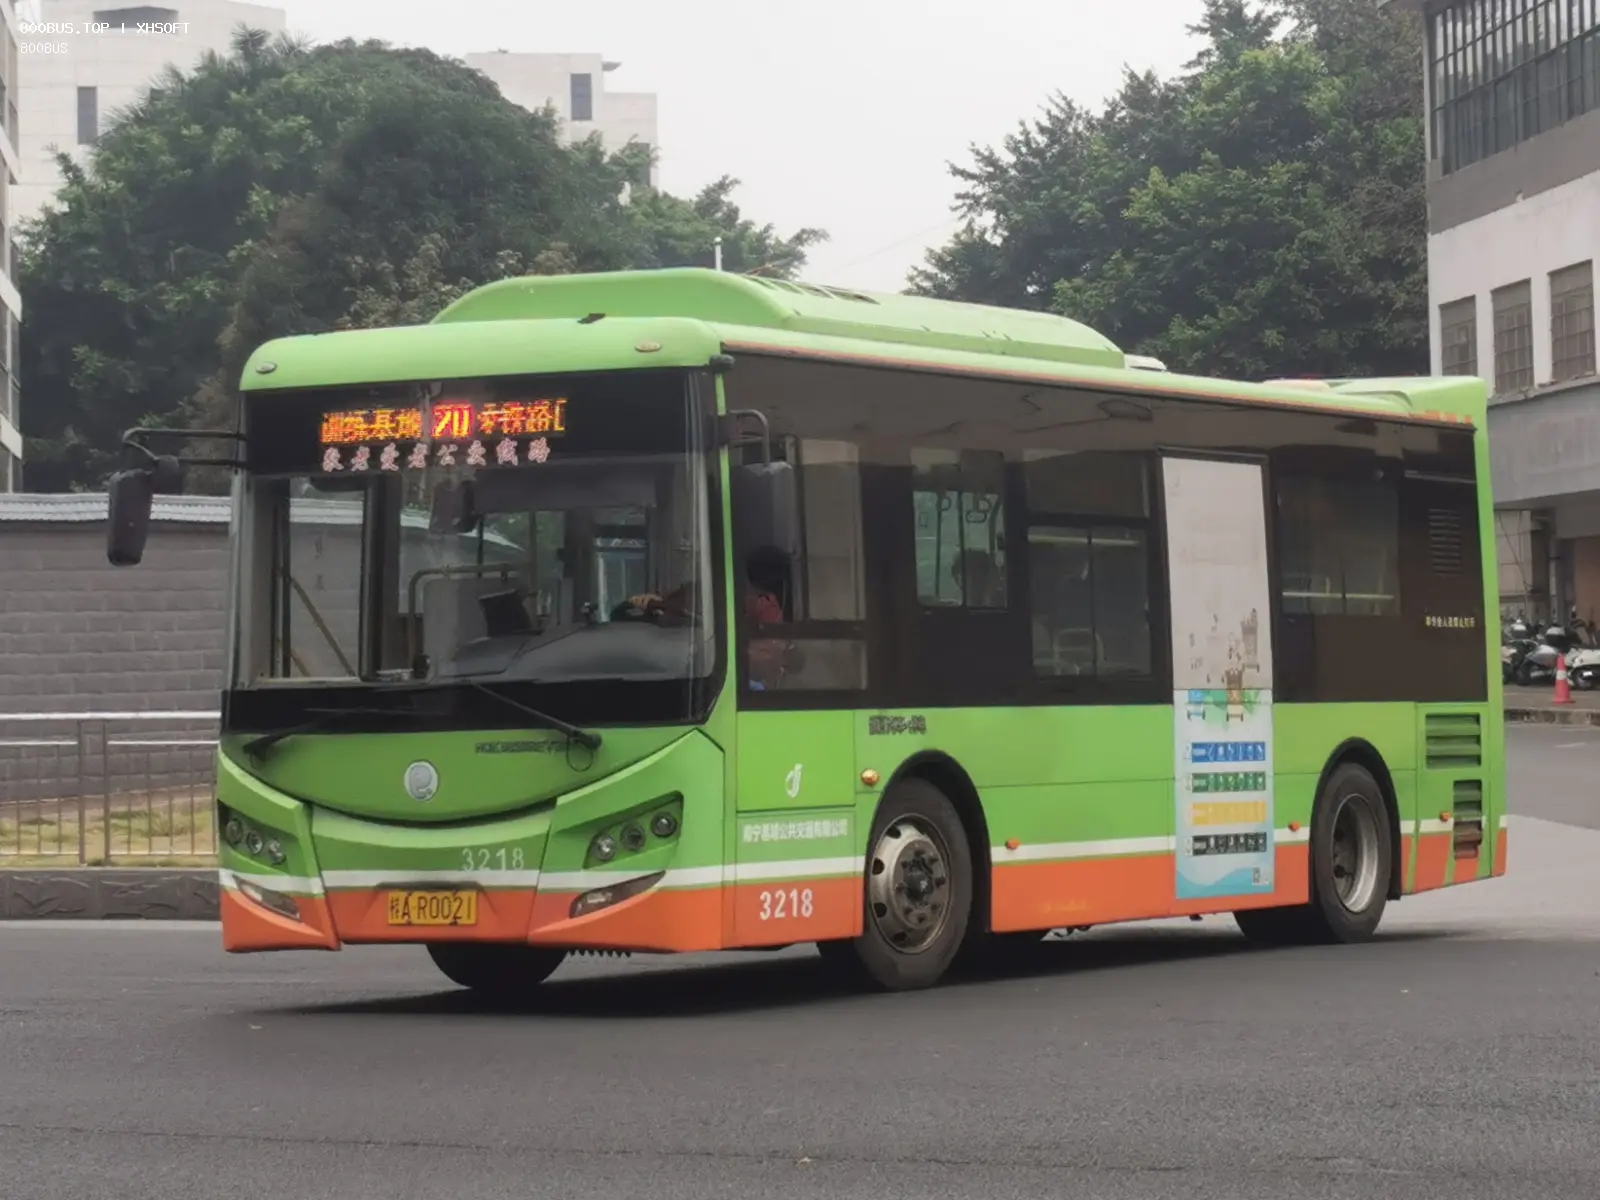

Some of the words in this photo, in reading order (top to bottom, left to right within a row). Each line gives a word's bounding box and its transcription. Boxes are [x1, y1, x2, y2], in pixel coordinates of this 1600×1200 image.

[432, 402, 474, 439] 70
[462, 847, 525, 872] 3218
[759, 887, 814, 921] 3218
